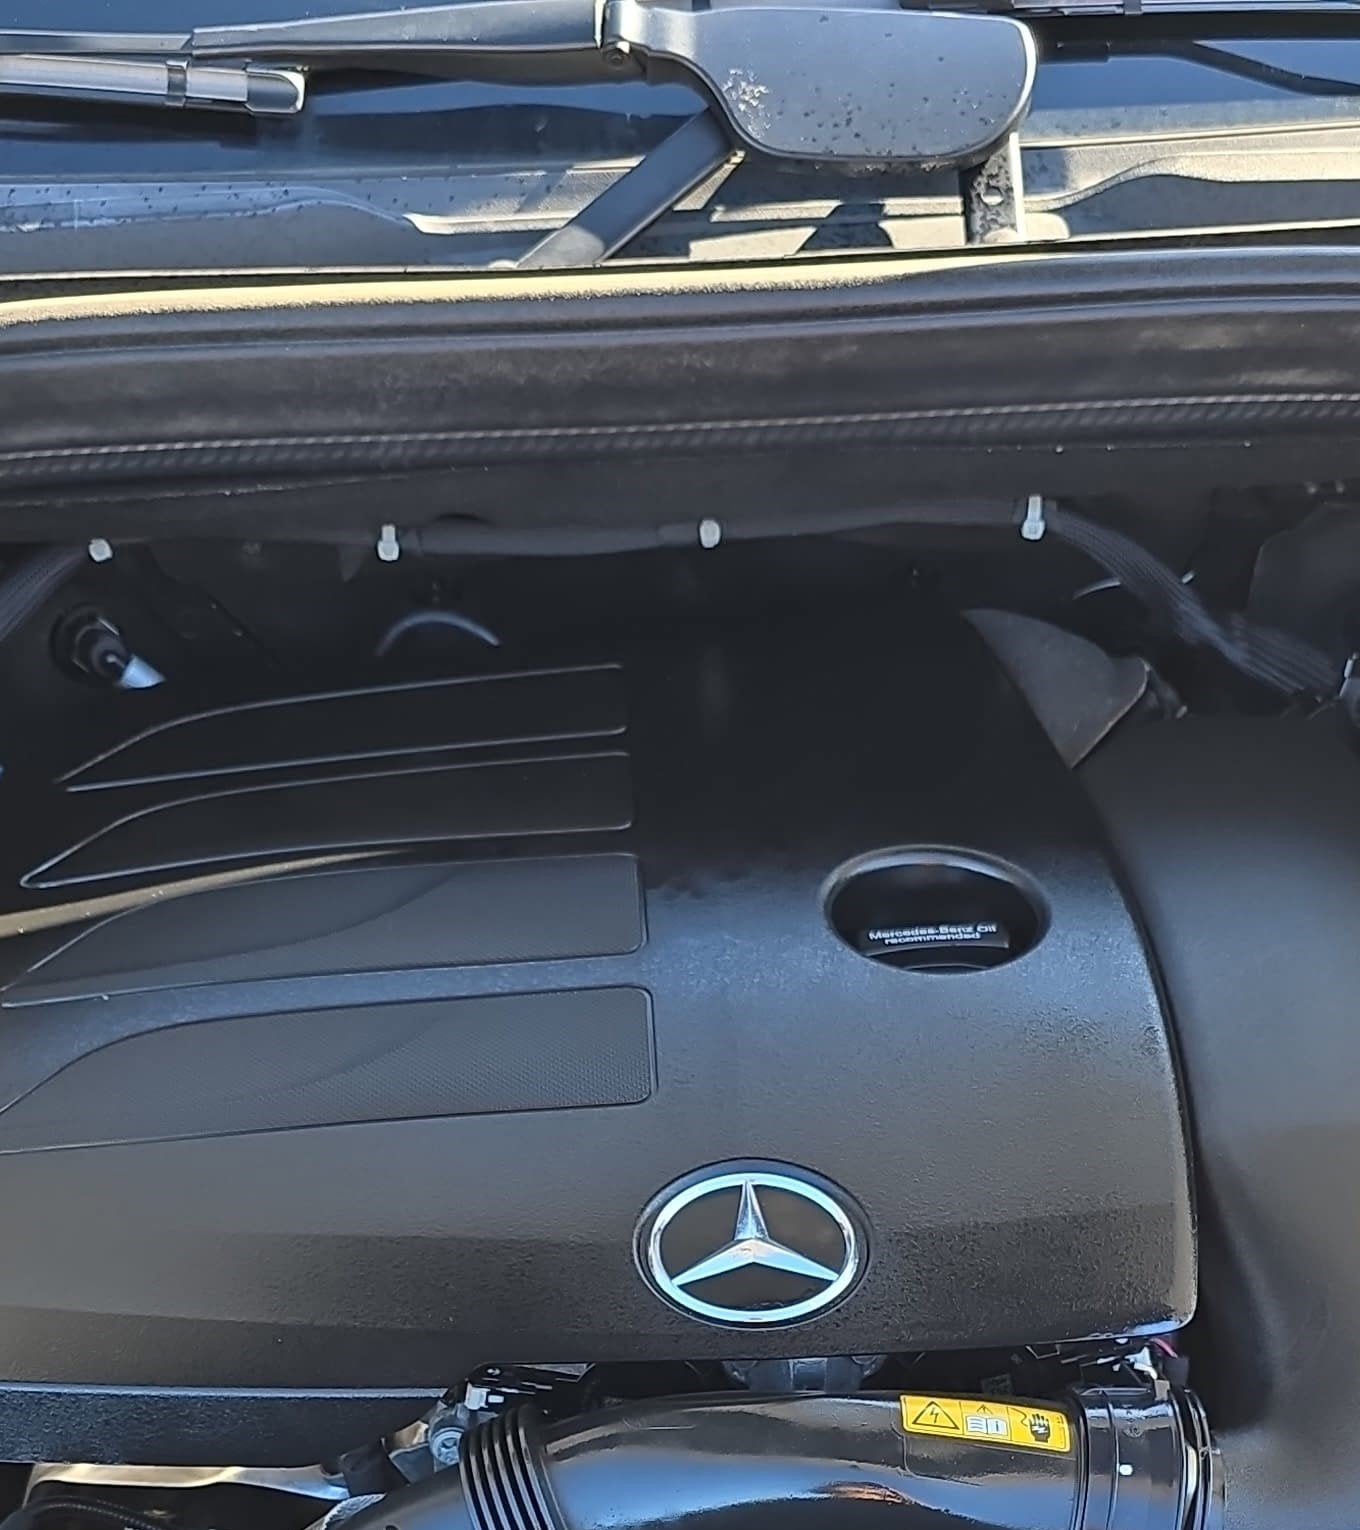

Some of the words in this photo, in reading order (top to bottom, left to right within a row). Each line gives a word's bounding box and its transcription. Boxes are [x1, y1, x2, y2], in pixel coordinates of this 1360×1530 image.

[869, 925, 973, 940] Mercedes-Benz
[977, 923, 997, 934] Oil
[884, 932, 981, 945] recommended
